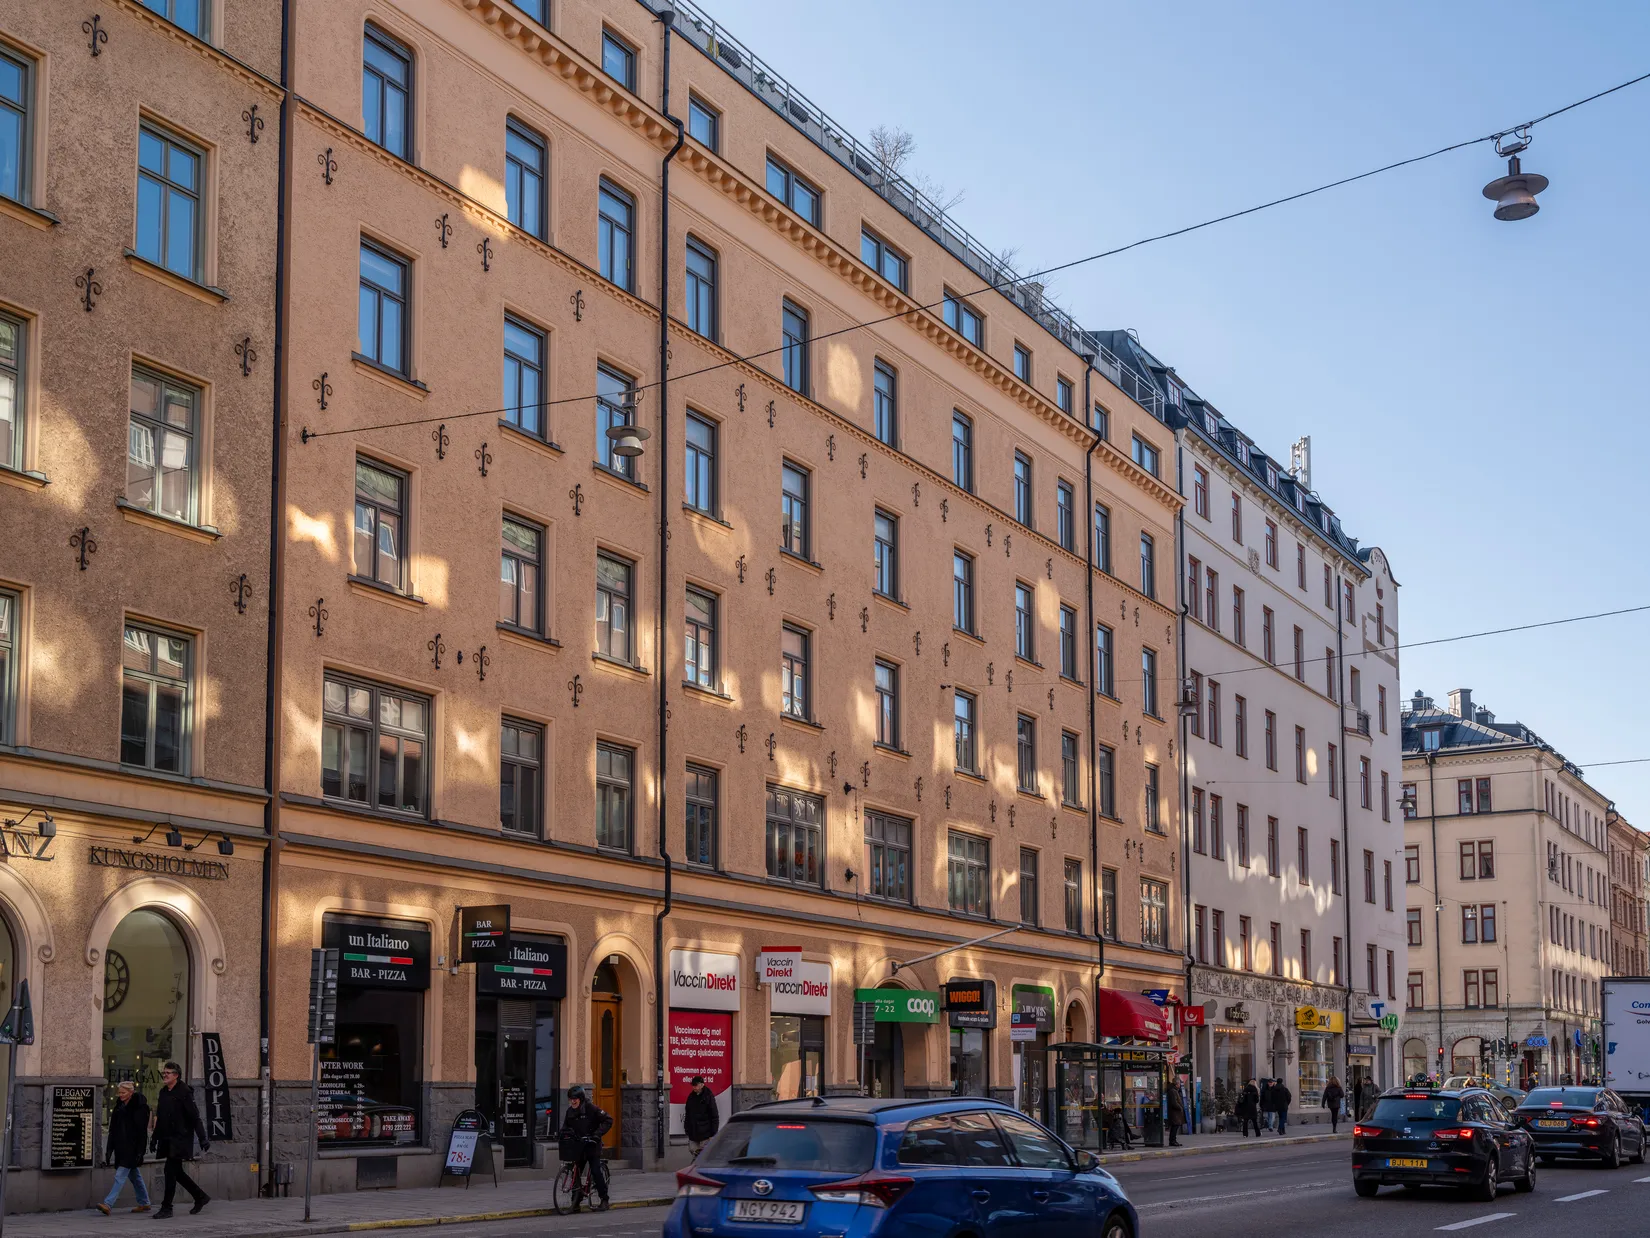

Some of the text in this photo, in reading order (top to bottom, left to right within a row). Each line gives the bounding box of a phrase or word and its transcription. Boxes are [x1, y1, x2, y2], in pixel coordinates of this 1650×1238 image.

[90, 845, 230, 878] KUNGSHOLMEN
[476, 920, 492, 929] BAR
[349, 933, 409, 951] un Italiano
[471, 940, 496, 948] PIZZA
[513, 947, 549, 962] Italiano
[766, 957, 793, 967] Vaccin
[351, 967, 370, 979] BAR
[378, 970, 407, 981] PIZZA
[766, 967, 793, 977] Direkt
[500, 978, 517, 989] BAR
[523, 980, 547, 991] PIZZA
[673, 970, 736, 991] VaccinDirekt
[774, 980, 828, 997] VaccinDirekt
[949, 990, 981, 1003] WIGGO!
[907, 998, 935, 1017] coop
[1371, 1003, 1384, 1017] T
[675, 1026, 701, 1035] Vaccinera
[701, 1028, 710, 1037] dig
[342, 1061, 364, 1069] WORK
[700, 1067, 706, 1075] på
[109, 1069, 164, 1083] ELEGAN
[55, 1088, 91, 1097] ELEGANZ
[211, 1103, 226, 1136] IN
[451, 1152, 470, 1163] 78:-
[1391, 1159, 1424, 1167] BJL 11A
[739, 1202, 797, 1218] NGY 942
